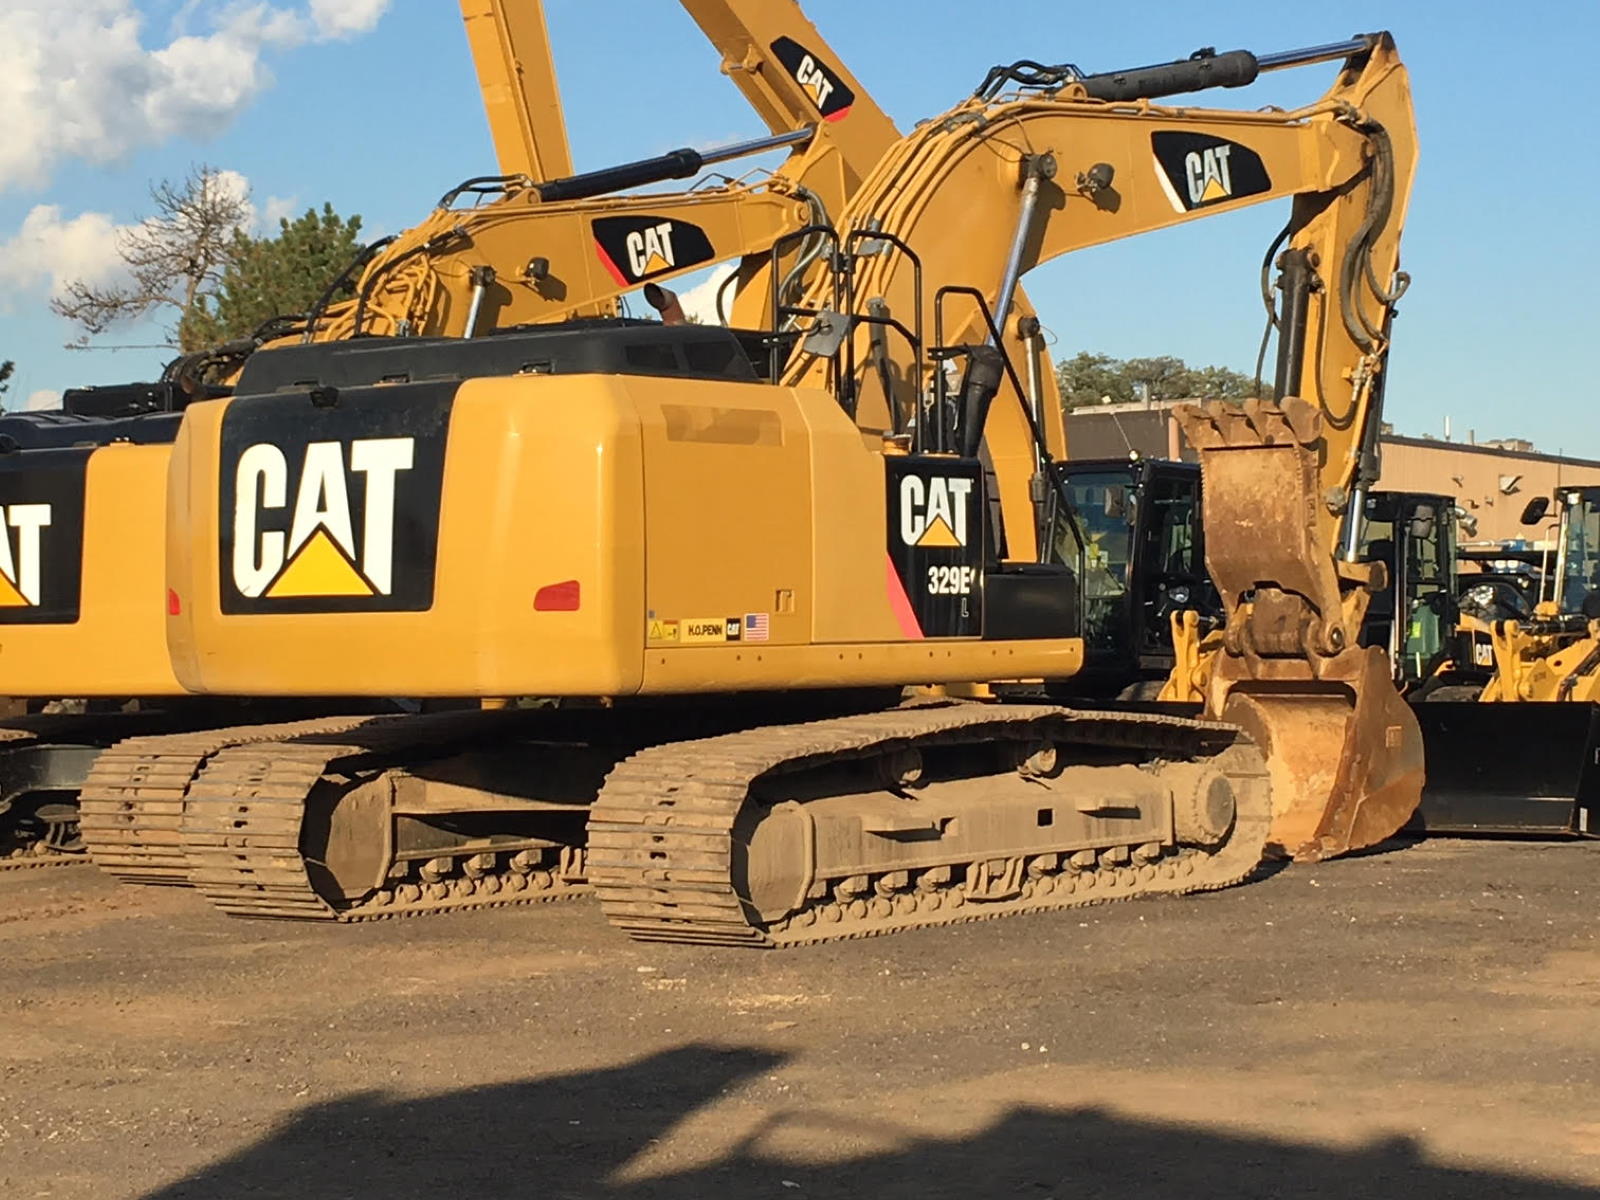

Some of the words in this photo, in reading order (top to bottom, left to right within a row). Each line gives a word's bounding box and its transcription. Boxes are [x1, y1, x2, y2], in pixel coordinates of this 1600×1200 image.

[796, 55, 834, 109] CAT
[1185, 144, 1232, 203] CAT
[626, 222, 675, 277] CAT
[233, 438, 414, 598] CAT
[900, 474, 971, 547] CAT
[928, 566, 970, 594] 329E
[1475, 643, 1492, 666] CAT
